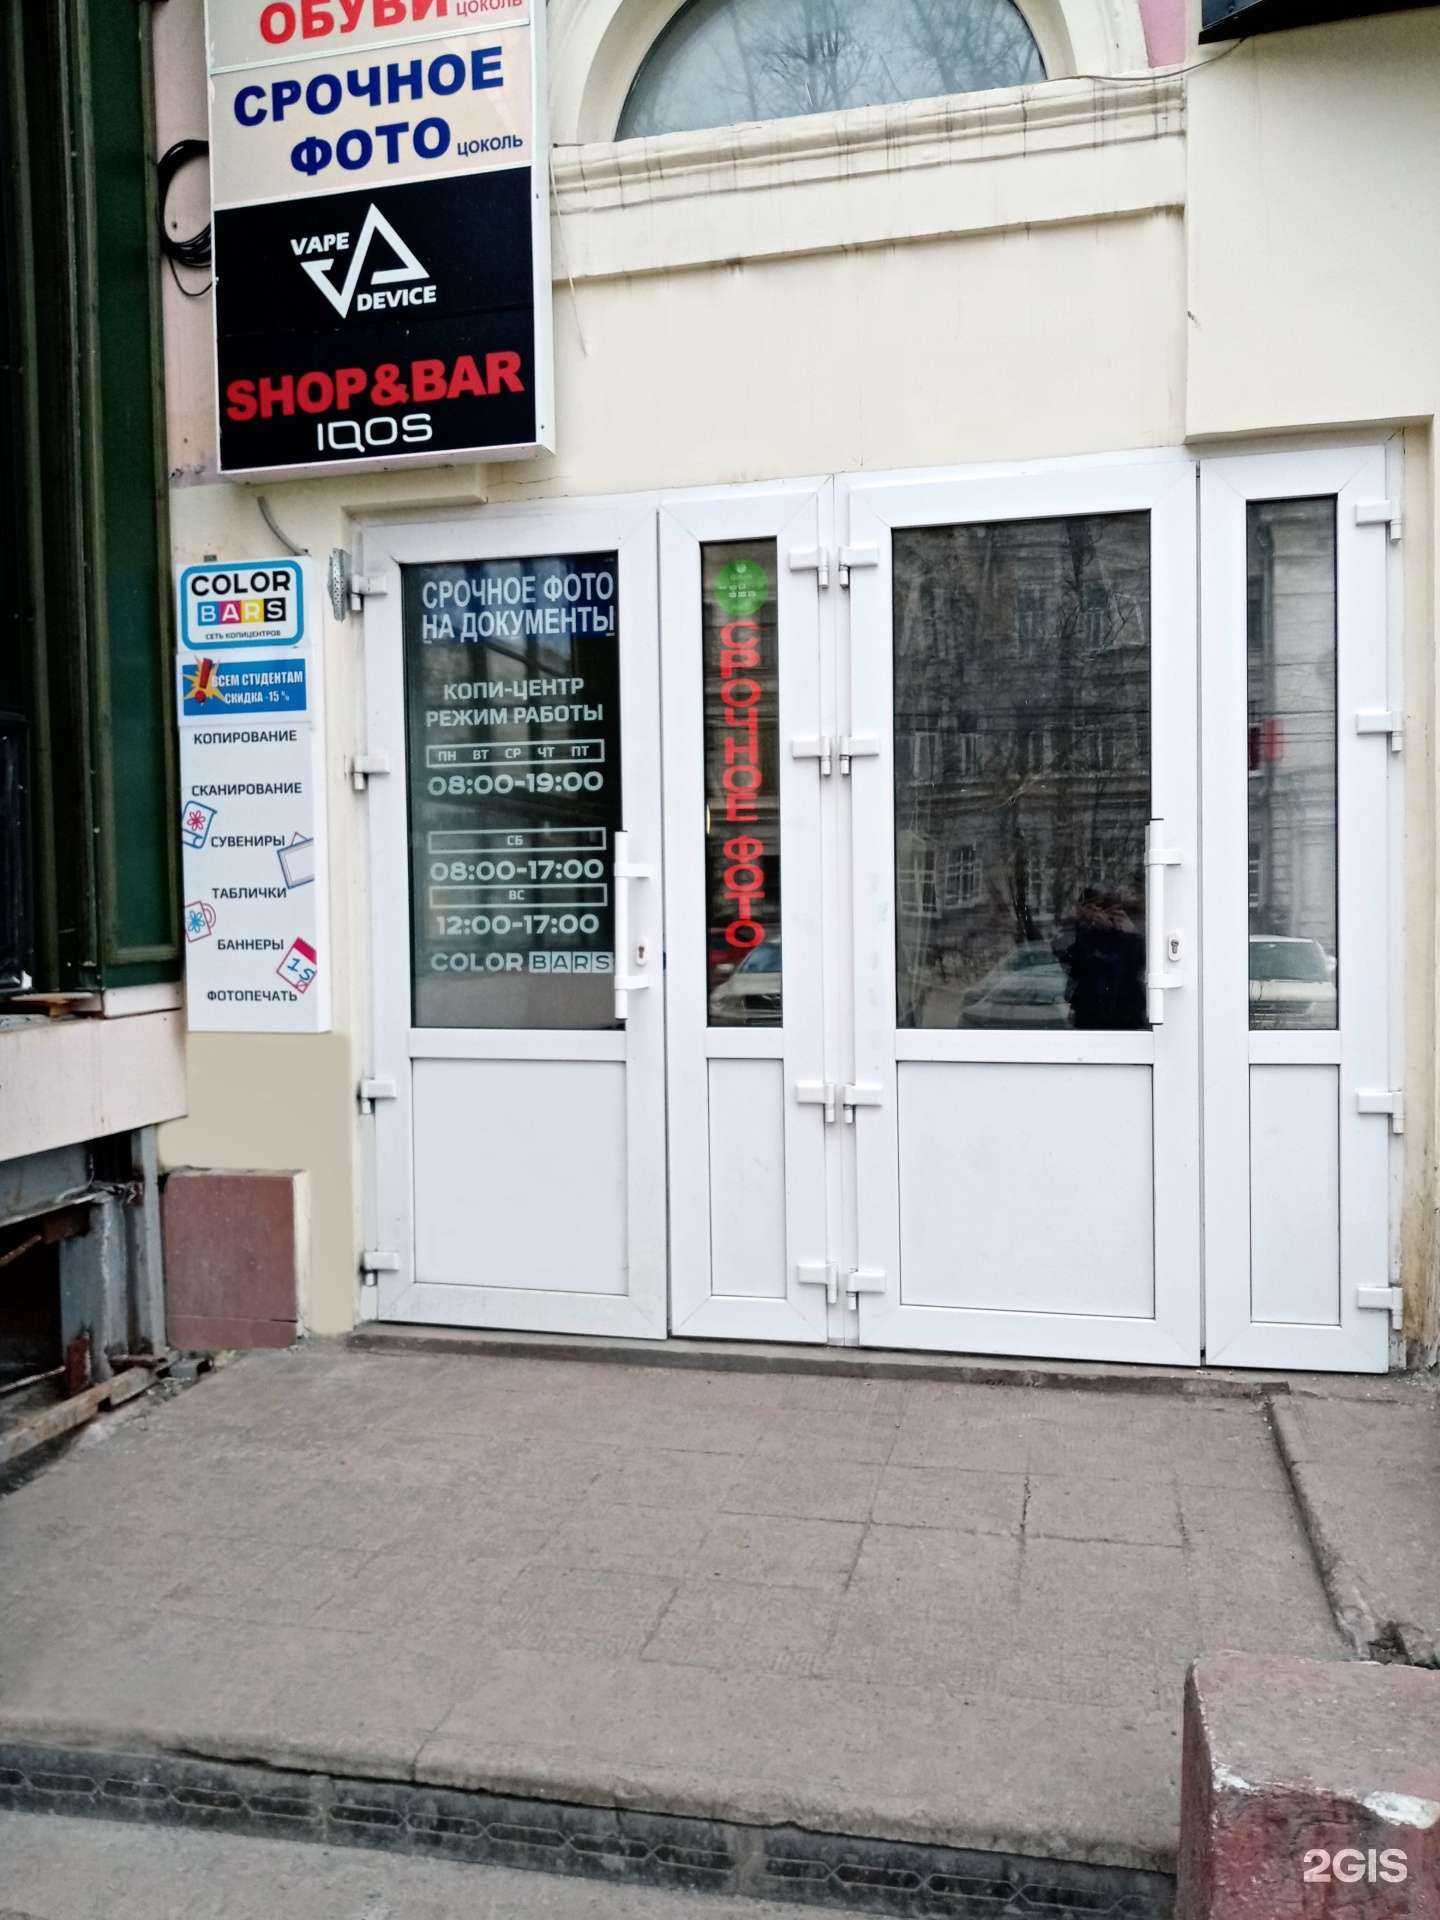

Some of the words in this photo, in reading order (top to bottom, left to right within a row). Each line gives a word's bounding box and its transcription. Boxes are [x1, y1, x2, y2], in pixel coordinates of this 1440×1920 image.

[234, 46, 503, 126] СРОЧНОЕ
[291, 117, 451, 176] ФОТО
[457, 134, 523, 157] ЦОКОЛЬ
[290, 232, 350, 256] VAPE
[357, 285, 437, 312] DEVICE
[227, 350, 524, 421] SHOP&BAR
[318, 413, 432, 452] IQOS
[191, 570, 291, 596] COLOR
[422, 576, 536, 609] СРОЧНОЕ
[543, 571, 614, 602] ФОТО
[200, 599, 284, 623] BARS
[206, 632, 223, 640] СЕТЬ
[225, 630, 281, 639] КОПИЦЕНТРОВ
[422, 613, 455, 640] НА
[460, 605, 615, 643] ДОКУМЕНТЫ
[212, 673, 240, 688] ВСЕМ
[242, 671, 303, 686] СТУДЕНТАМ
[444, 677, 585, 701] КОПИ-ЦЕНТР
[225, 691, 263, 704] СКИДКА
[426, 707, 508, 728] РЕЖИМ
[513, 704, 604, 725] РАБОТЫ
[719, 621, 763, 822] СРОЧНОЕ
[193, 729, 298, 745] КОПИРОВАНИЕ
[437, 750, 457, 762] ПН
[472, 748, 489, 761] ВТ
[504, 747, 521, 760] СР
[537, 746, 555, 759] ЧТ
[571, 745, 589, 757] ПТ
[191, 782, 302, 797] СКАНИРОВАНИЕ
[428, 771, 604, 796] 08:00-19:00
[210, 835, 285, 848] СУВЕНИРЫ
[507, 835, 524, 846] СБ
[429, 858, 604, 881] 08:00-17:00
[212, 887, 287, 899] ТАБЛИЧКИ
[508, 890, 525, 901] ВС
[723, 834, 765, 948] ФОТО
[436, 914, 599, 936] 12:00-17:00
[217, 938, 284, 950] БАННЕРЫ
[430, 952, 524, 972] COLOR
[531, 953, 612, 972] BARS
[207, 990, 298, 1002] ФОТОПЕЧАТЬ
